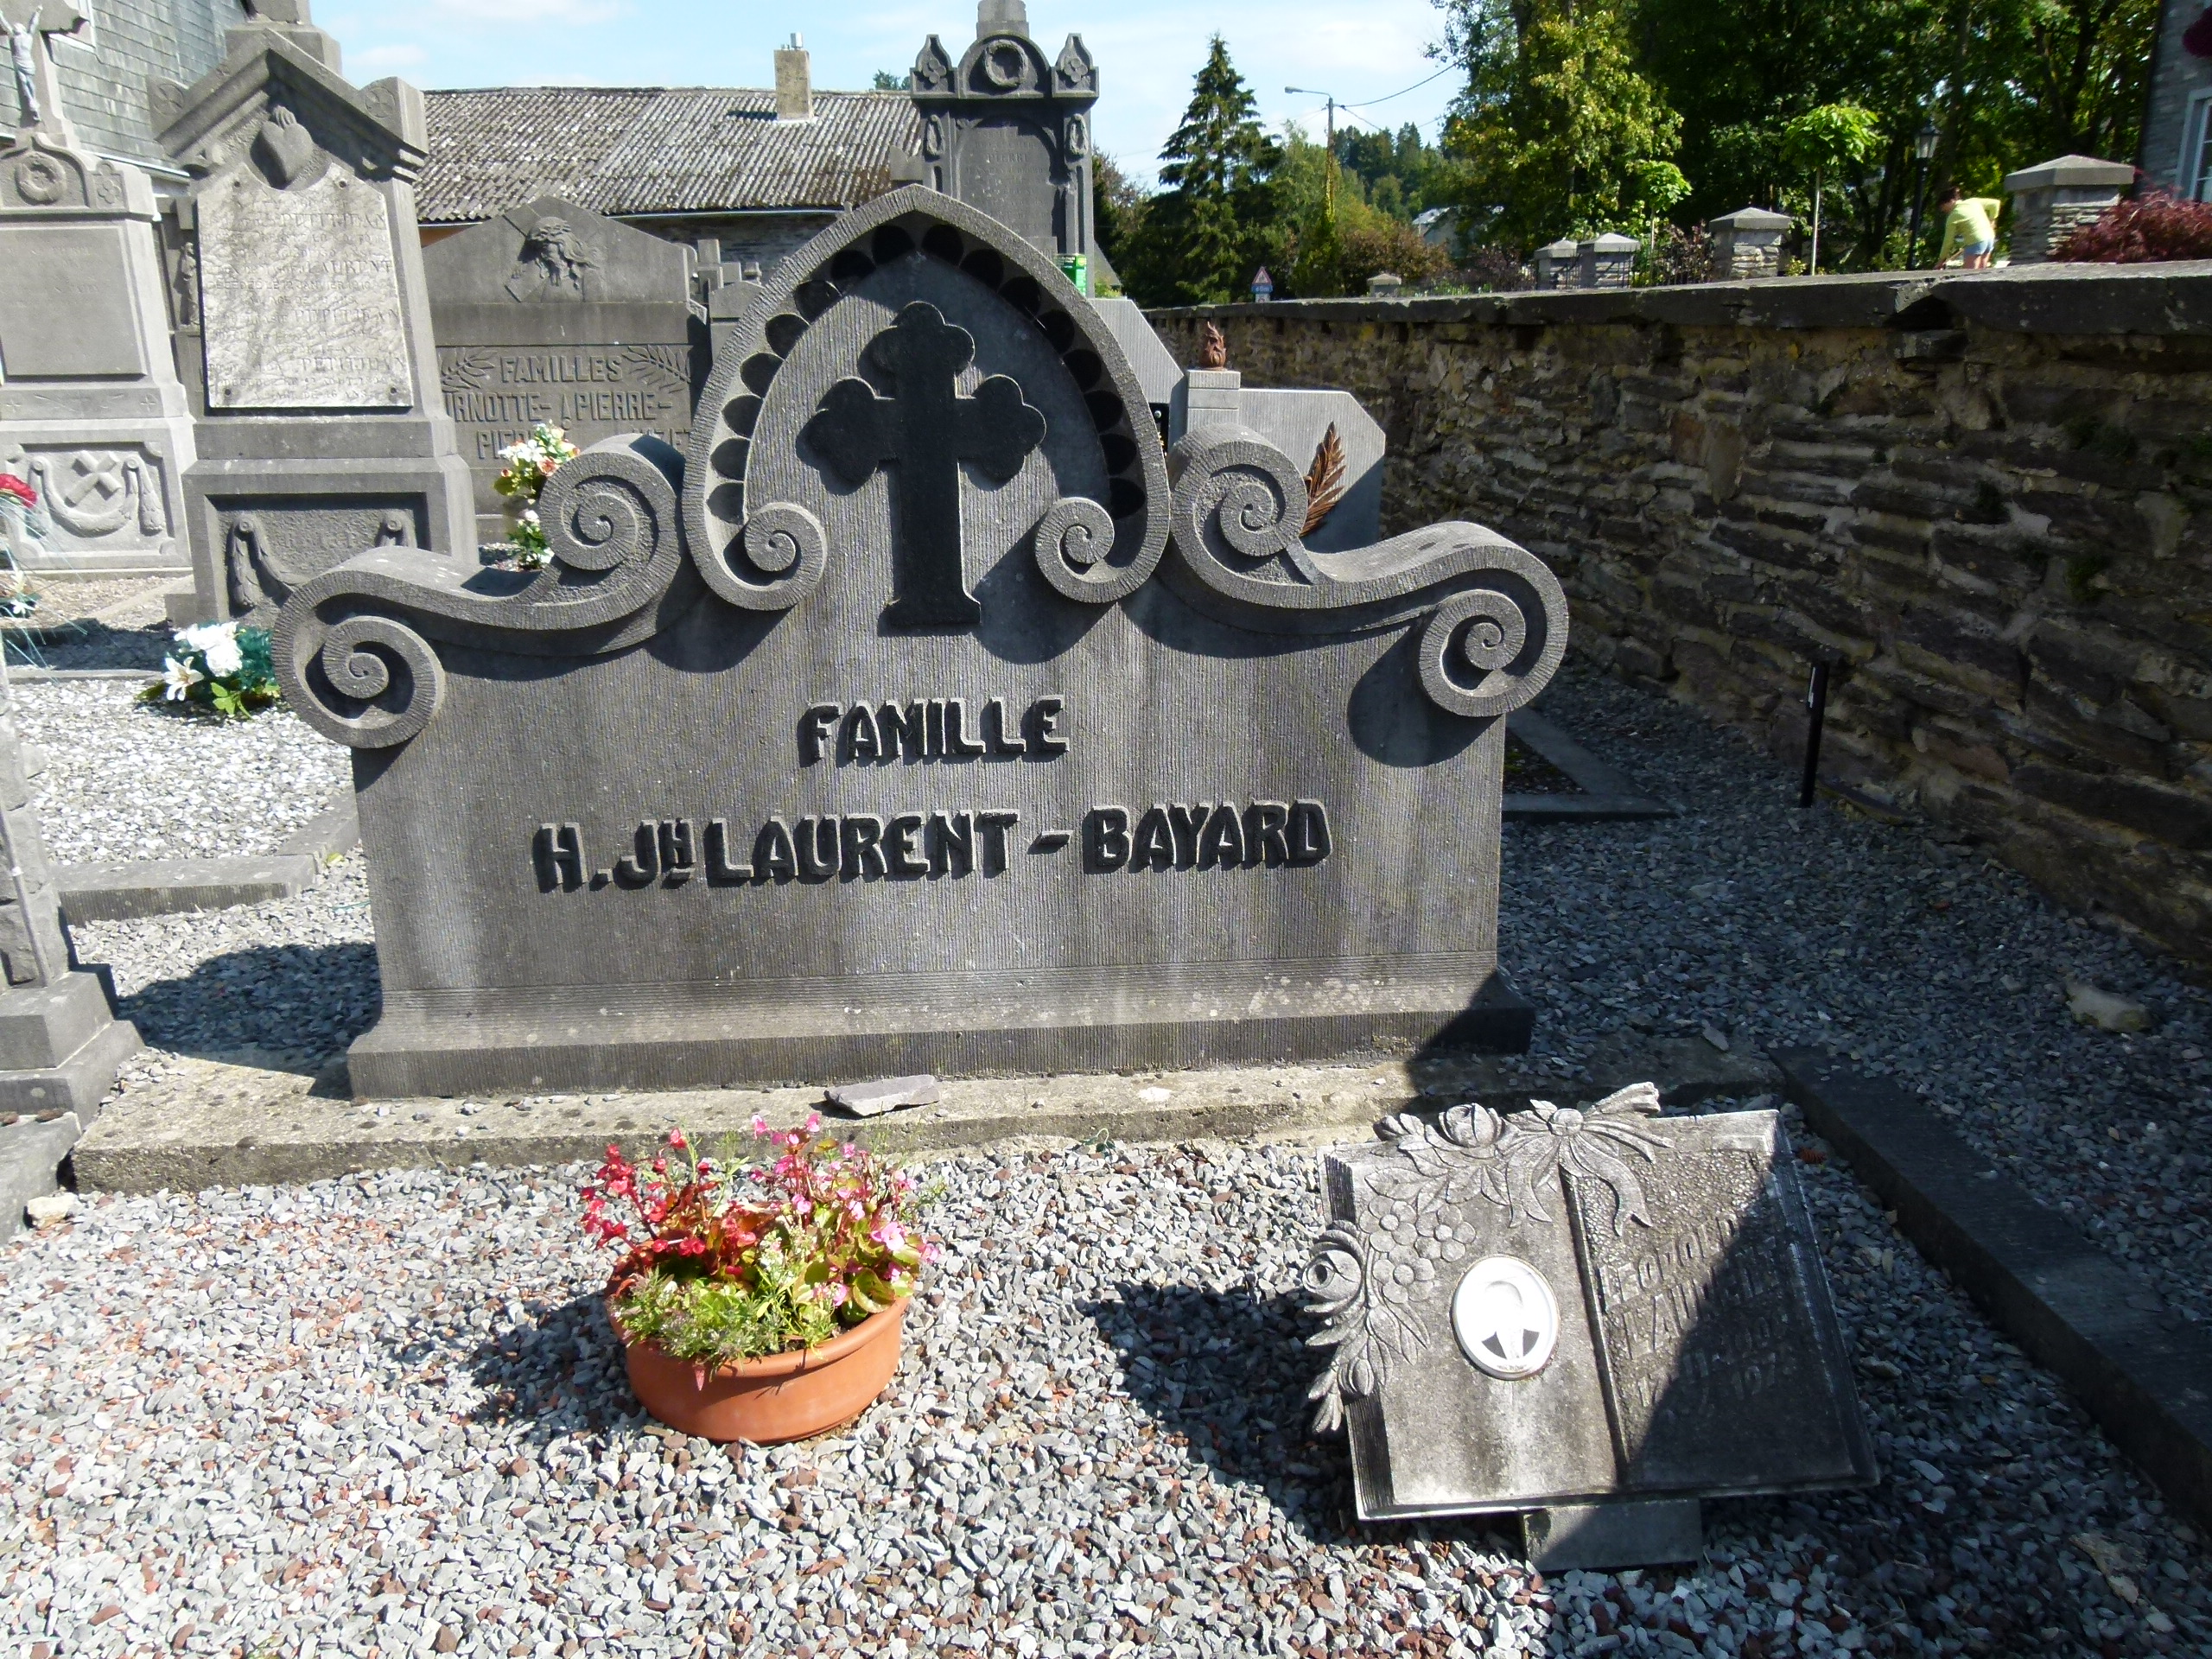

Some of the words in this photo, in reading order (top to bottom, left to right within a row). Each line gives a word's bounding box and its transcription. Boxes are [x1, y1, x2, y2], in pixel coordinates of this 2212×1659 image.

[500, 355, 623, 383] FAMILLES
[798, 694, 1070, 766] FAMILLE
[1082, 797, 1334, 874] BAYARD
[1595, 1211, 1740, 1314] LEOPOLD
